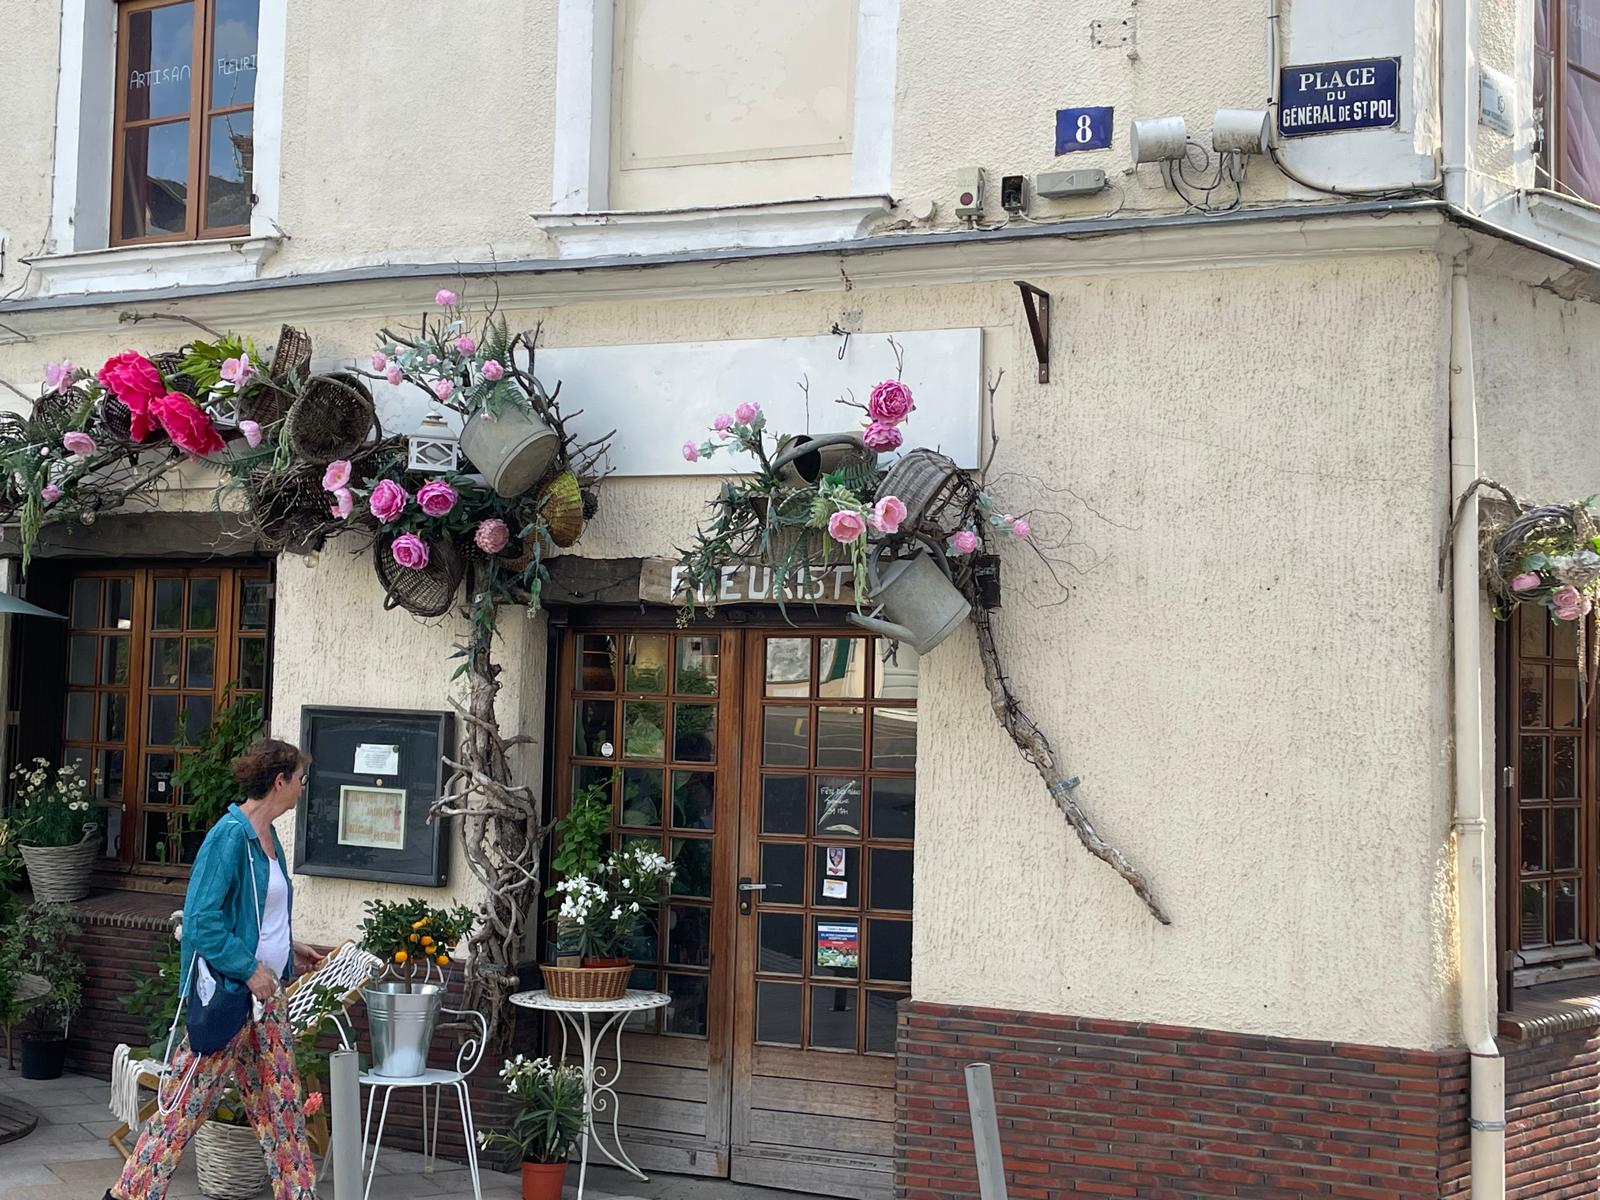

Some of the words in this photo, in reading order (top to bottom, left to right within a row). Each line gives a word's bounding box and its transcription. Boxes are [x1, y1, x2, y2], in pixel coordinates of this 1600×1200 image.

[1298, 67, 1376, 92] PLACE
[1326, 90, 1346, 101] DU
[1282, 103, 1337, 127] GÉNÉRAL
[1339, 105, 1351, 122] DE
[1370, 99, 1395, 119] POL
[1075, 114, 1093, 143] 8
